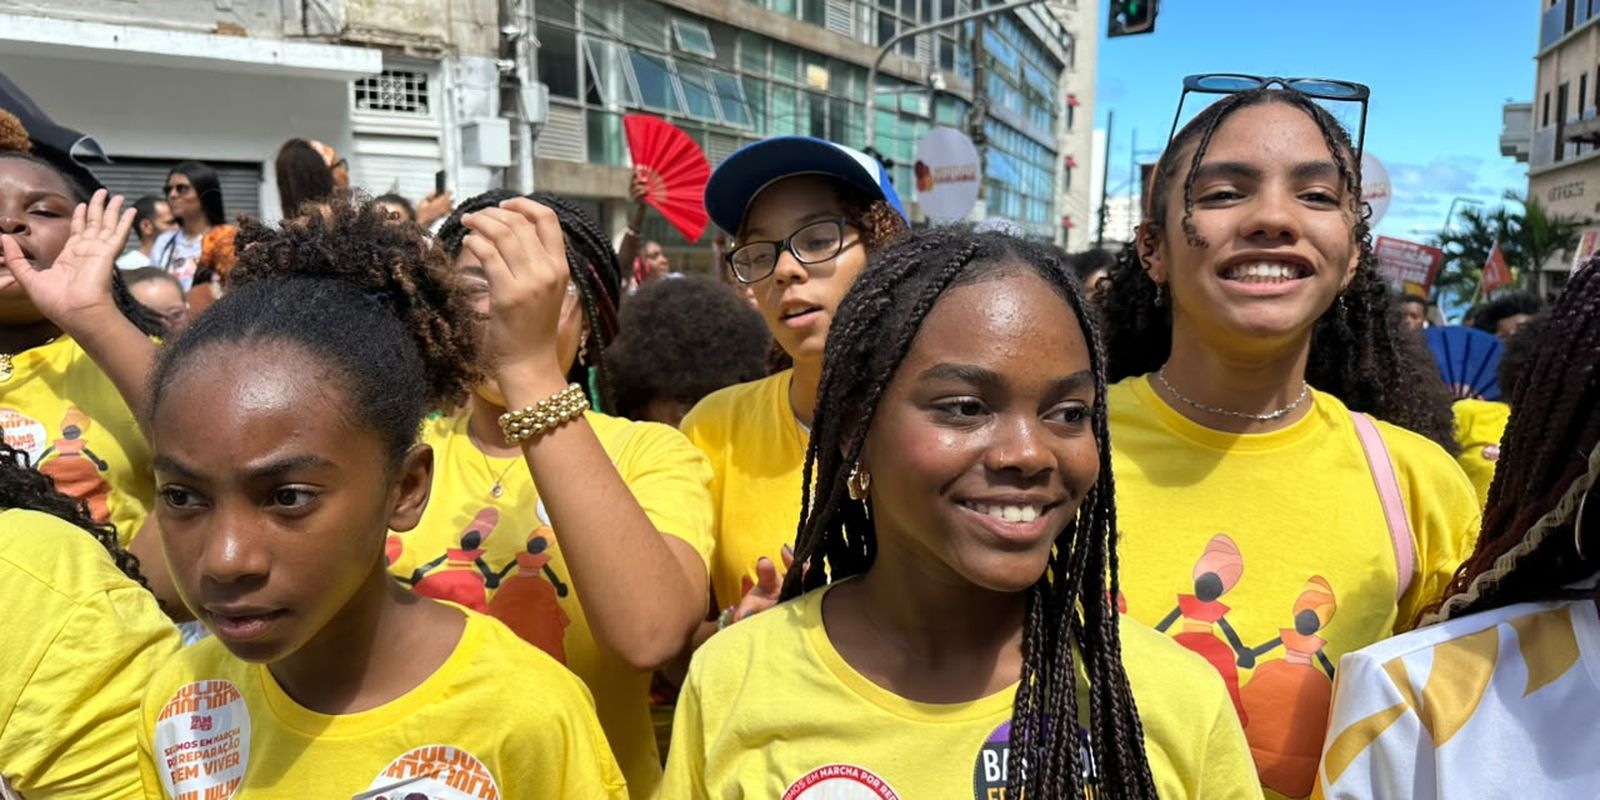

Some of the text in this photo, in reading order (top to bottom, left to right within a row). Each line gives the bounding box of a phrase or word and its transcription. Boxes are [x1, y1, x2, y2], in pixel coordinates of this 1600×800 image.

[178, 738, 240, 765] REPARAÇÃO
[200, 737, 212, 747] EM
[203, 751, 240, 776] VIVER
[806, 772, 820, 785] EM
[820, 766, 859, 778] MARCHA
[860, 771, 880, 788] POR
